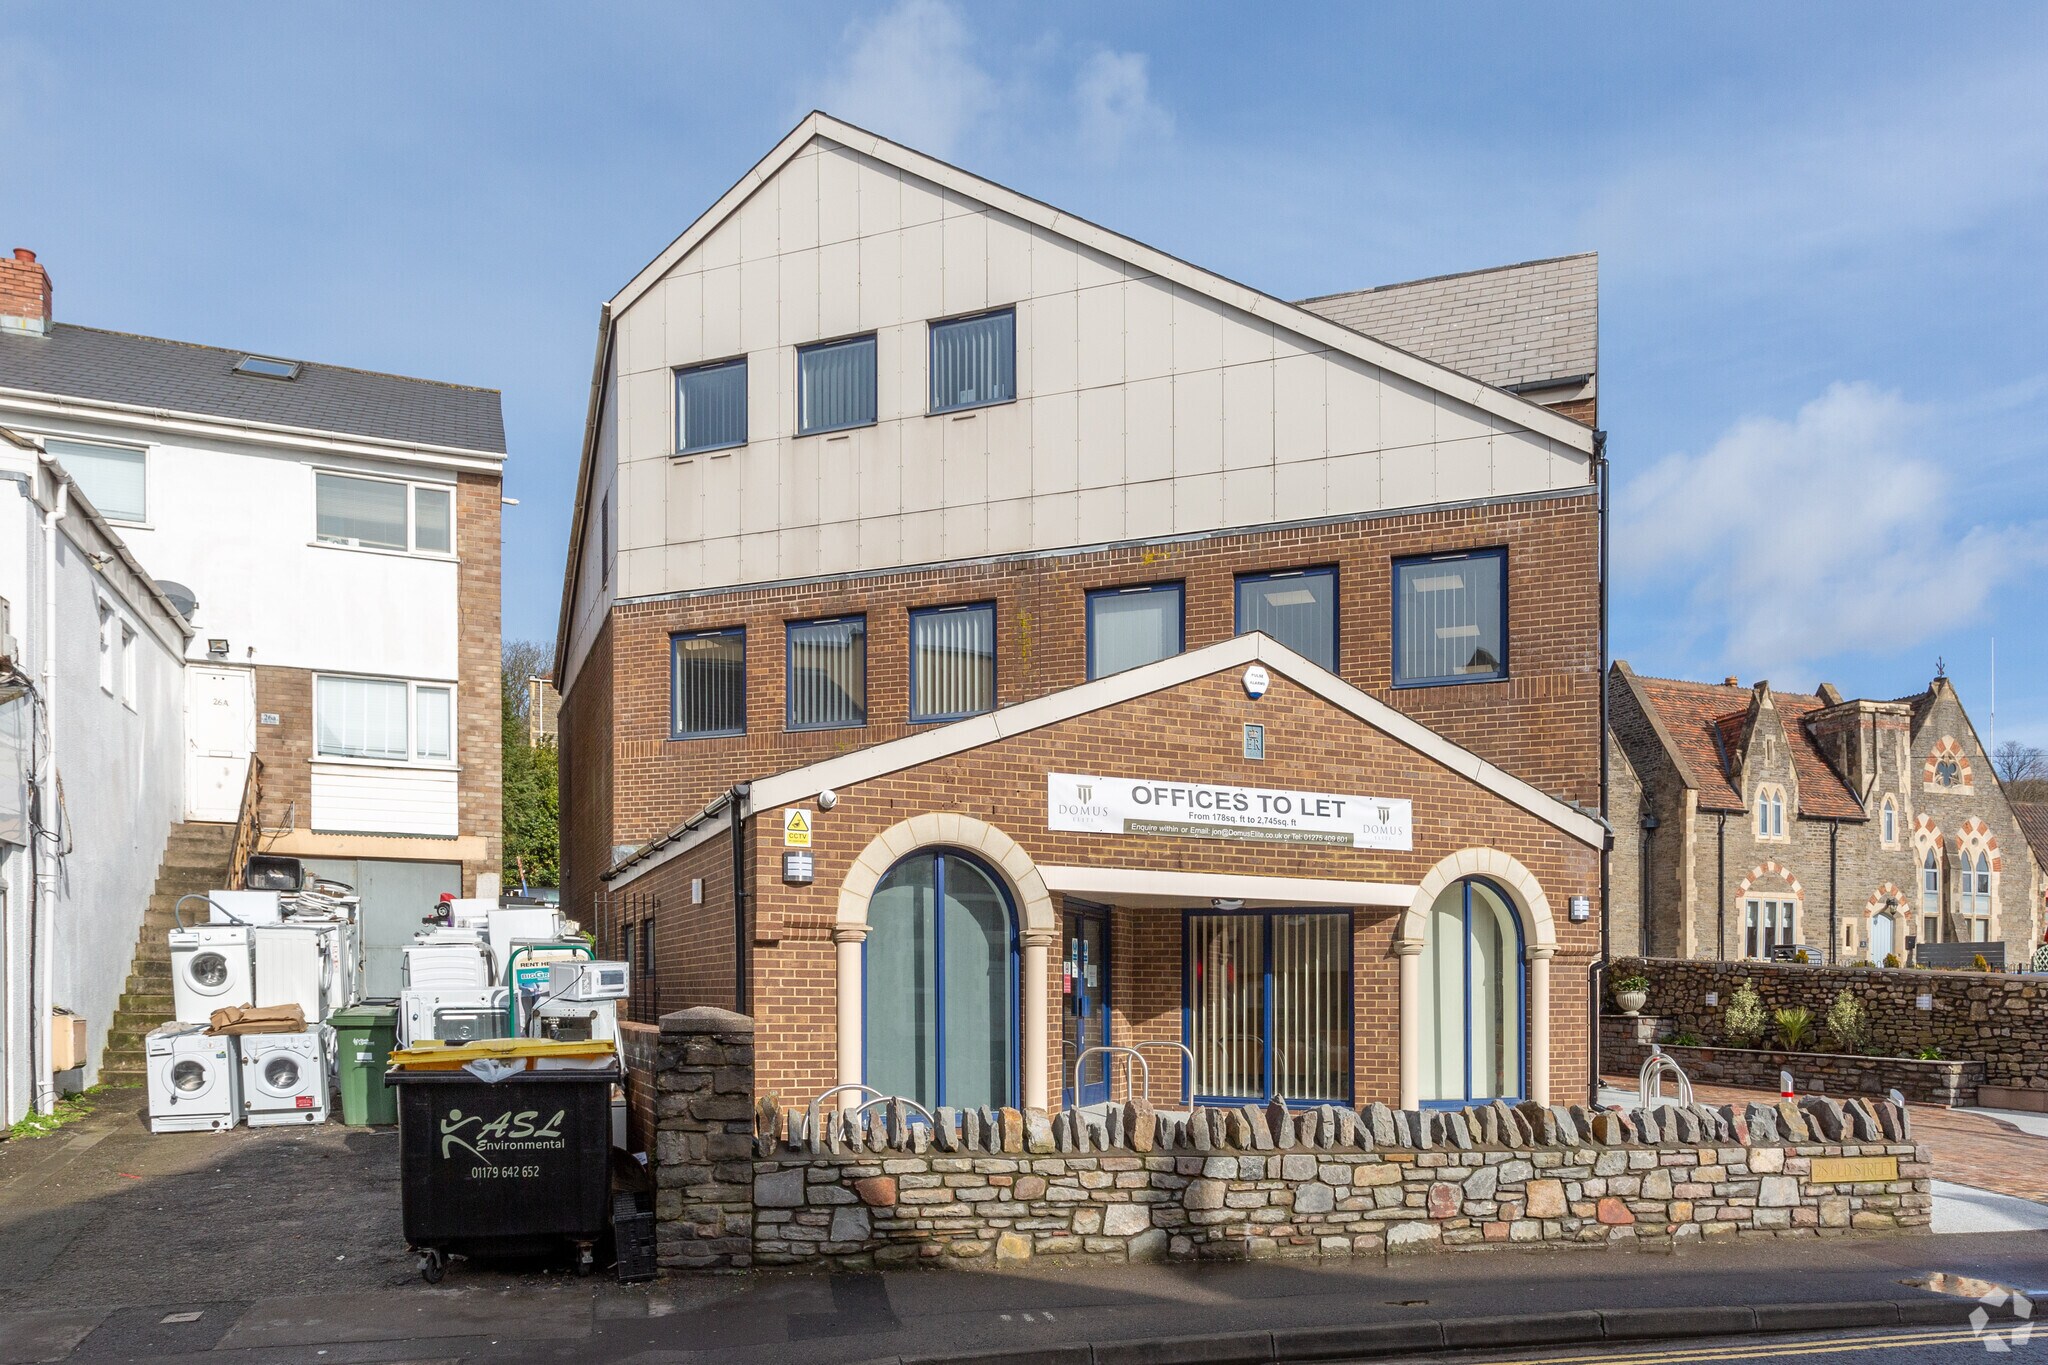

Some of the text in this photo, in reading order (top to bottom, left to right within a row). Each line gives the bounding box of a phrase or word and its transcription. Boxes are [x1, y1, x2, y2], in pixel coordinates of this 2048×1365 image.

[213, 698, 229, 706] 26A
[1246, 738, 1260, 750] ER
[1131, 785, 1346, 818] OFFICES TO LET
[1058, 804, 1109, 817] DOMUS
[1188, 812, 1210, 821] From
[1213, 813, 1237, 824] 178sq.
[1239, 815, 1245, 823] ft
[1257, 816, 1289, 827] 2,745sq.
[1131, 823, 1158, 832] Enquire
[1159, 825, 1179, 833] within
[1190, 826, 1210, 835] Email:
[1303, 834, 1322, 842] 01275
[1363, 824, 1403, 836] DOMUS
[476, 1109, 565, 1139] ASL
[476, 1138, 565, 1151] Environmental
[472, 1165, 540, 1179] 01179 642 652
[1830, 1163, 1852, 1177] OLD
[1854, 1161, 1896, 1177] STREET
